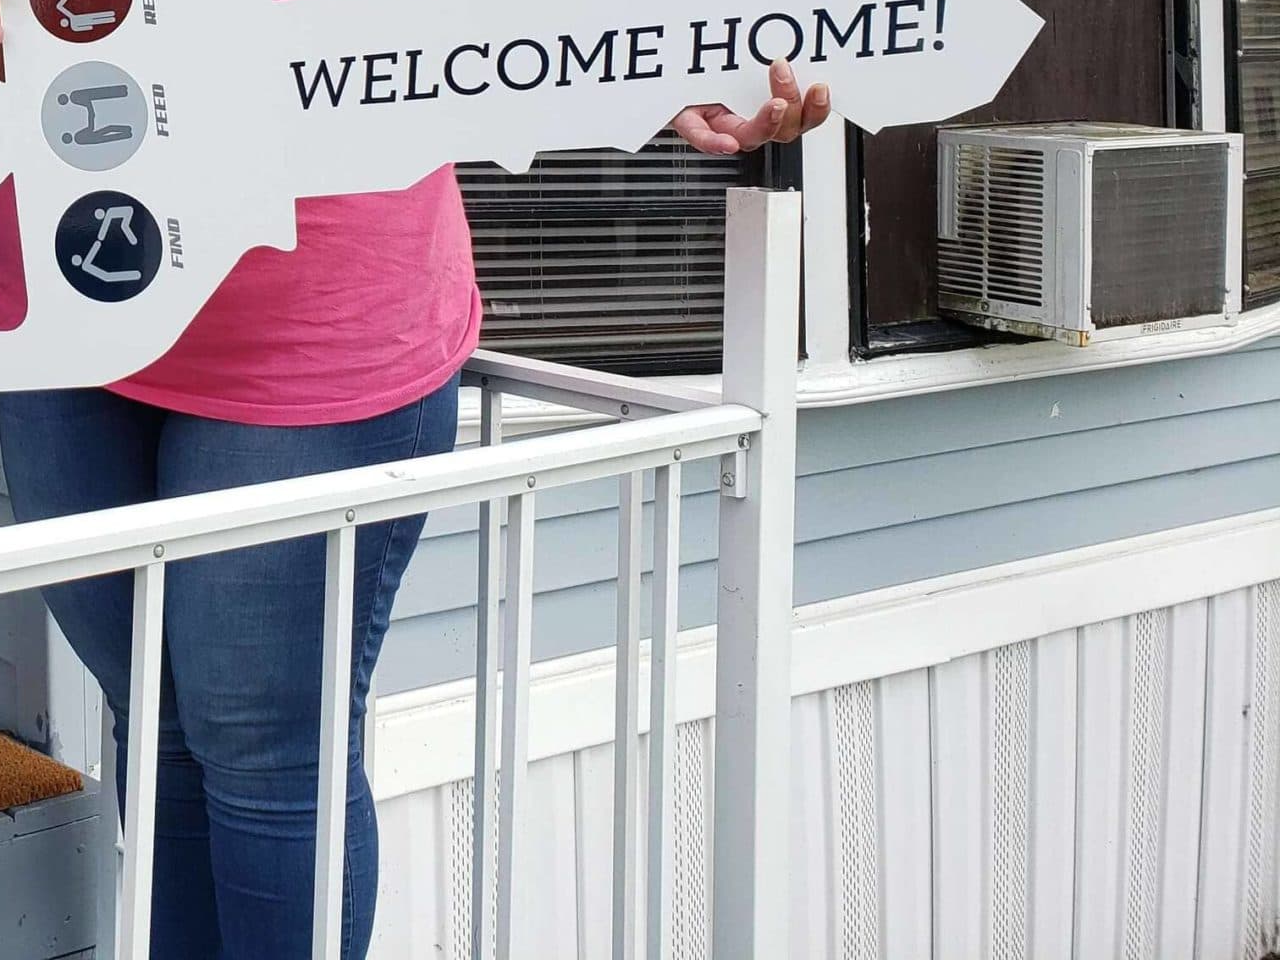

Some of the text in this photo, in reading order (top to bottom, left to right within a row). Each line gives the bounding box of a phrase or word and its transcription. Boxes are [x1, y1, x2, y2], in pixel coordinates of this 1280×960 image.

[289, 24, 665, 110] WELCOME
[152, 83, 169, 137] FEED
[167, 218, 184, 269] FIND
